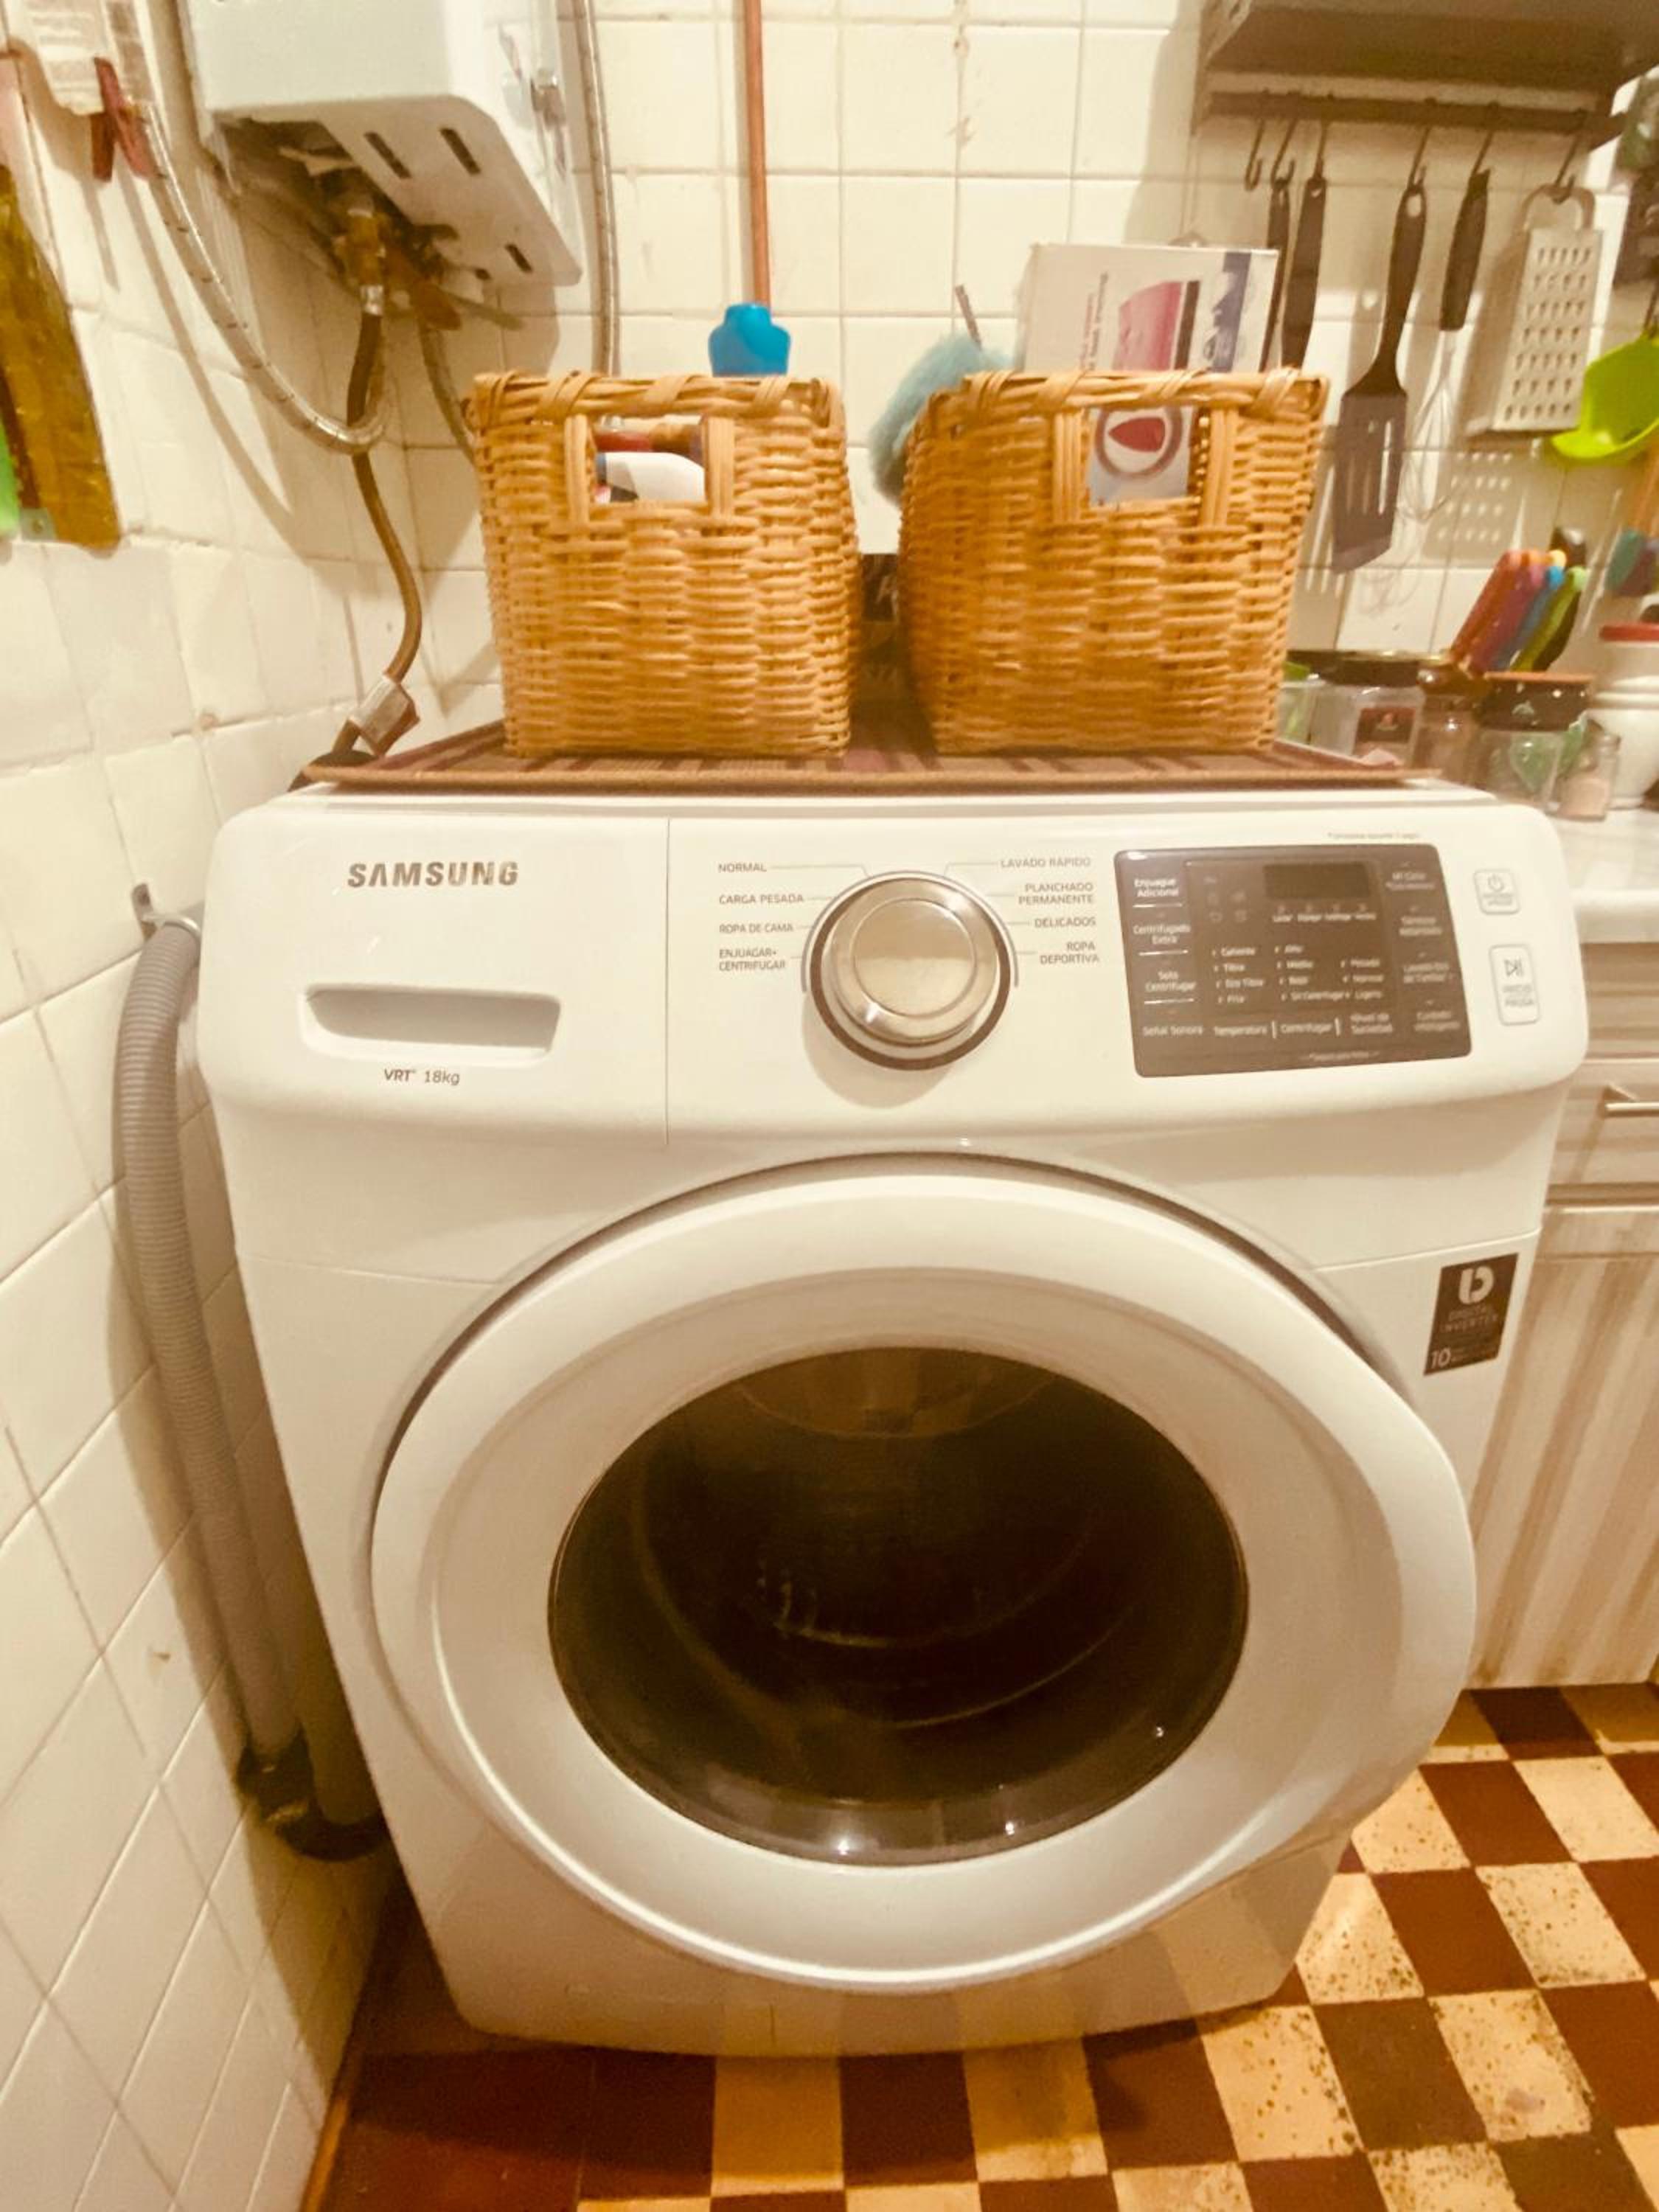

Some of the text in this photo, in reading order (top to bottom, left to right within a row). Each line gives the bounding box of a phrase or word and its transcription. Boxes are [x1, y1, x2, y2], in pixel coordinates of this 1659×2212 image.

[717, 862, 767, 873] NORMAL
[1001, 857, 1046, 869] LAVADO
[347, 860, 518, 888] SAMSUNG
[1024, 881, 1093, 893] PLANCHADO
[719, 892, 805, 905] CARGA PESADA
[1018, 894, 1093, 905] PERMANENTE
[719, 922, 795, 934] ROPA DE CAMA
[1034, 917, 1096, 928] DELICADOS
[1066, 941, 1096, 951] ROPA
[1039, 953, 1100, 965] DEPORTIVA
[719, 959, 786, 972] CENTRIFUGAR
[424, 1069, 460, 1086] 18kg
[1430, 1346, 1452, 1370] 10
